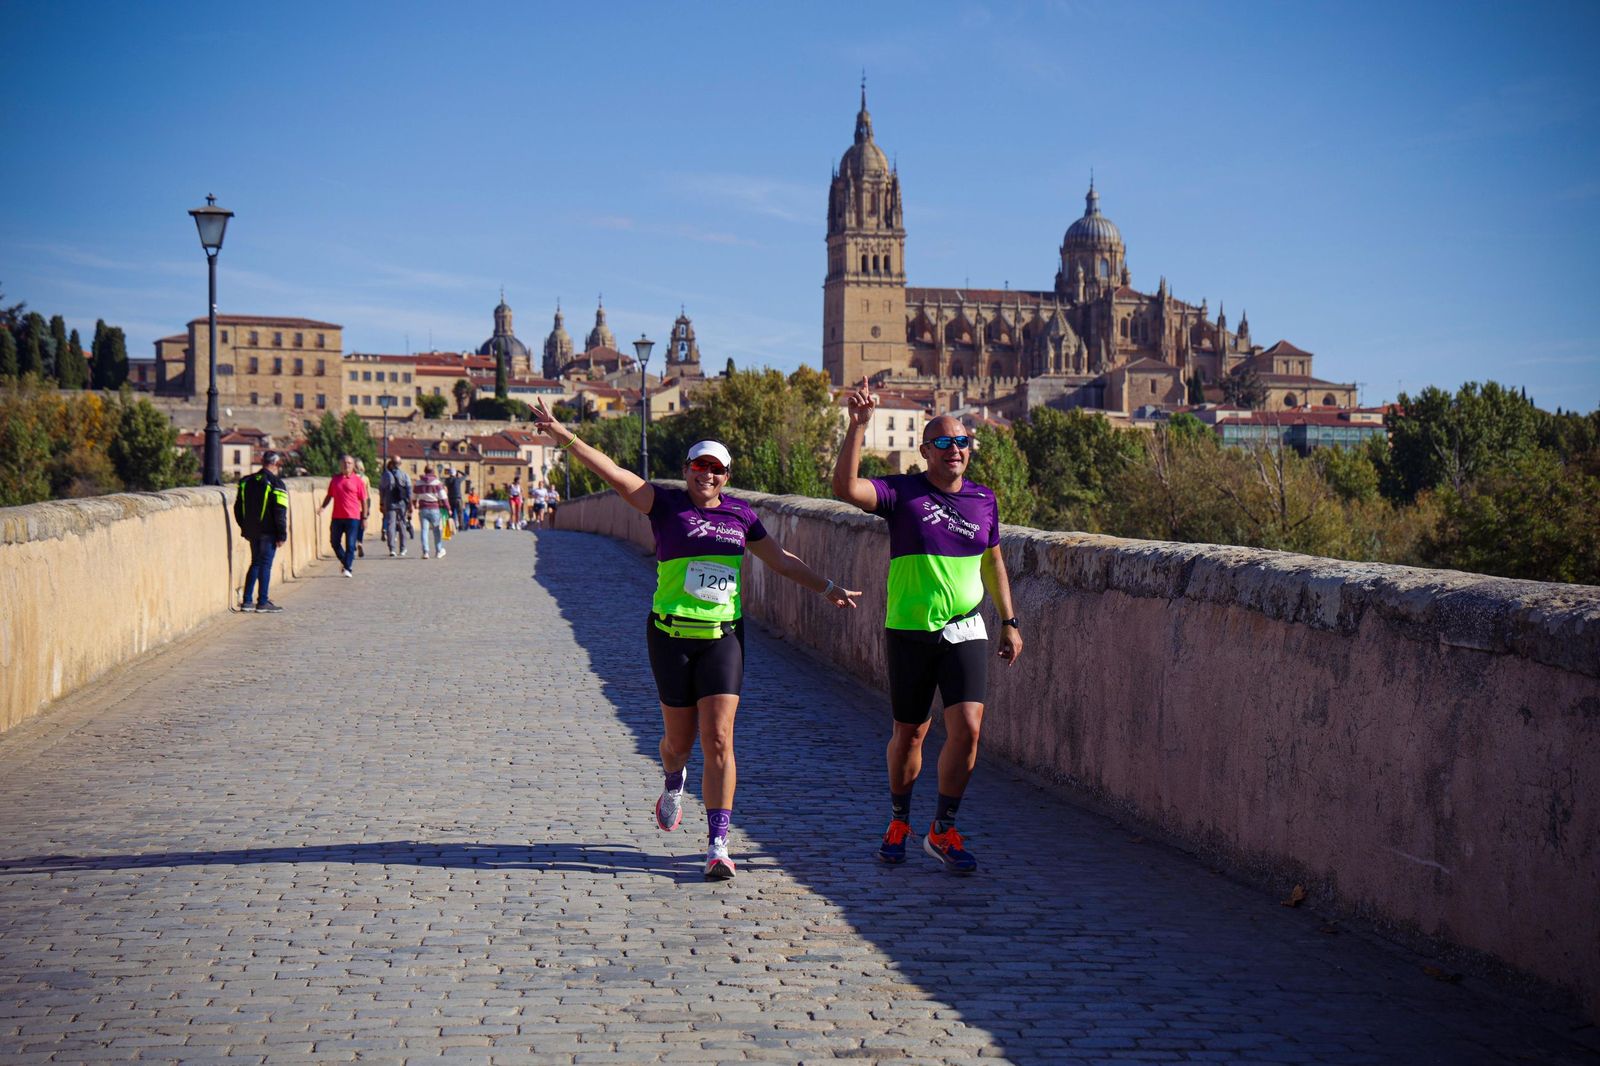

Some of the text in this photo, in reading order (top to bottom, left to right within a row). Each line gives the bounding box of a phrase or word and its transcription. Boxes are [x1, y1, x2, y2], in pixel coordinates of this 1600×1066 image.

[947, 523, 975, 540] Running
[715, 534, 741, 547] Running
[699, 573, 728, 591] 120
